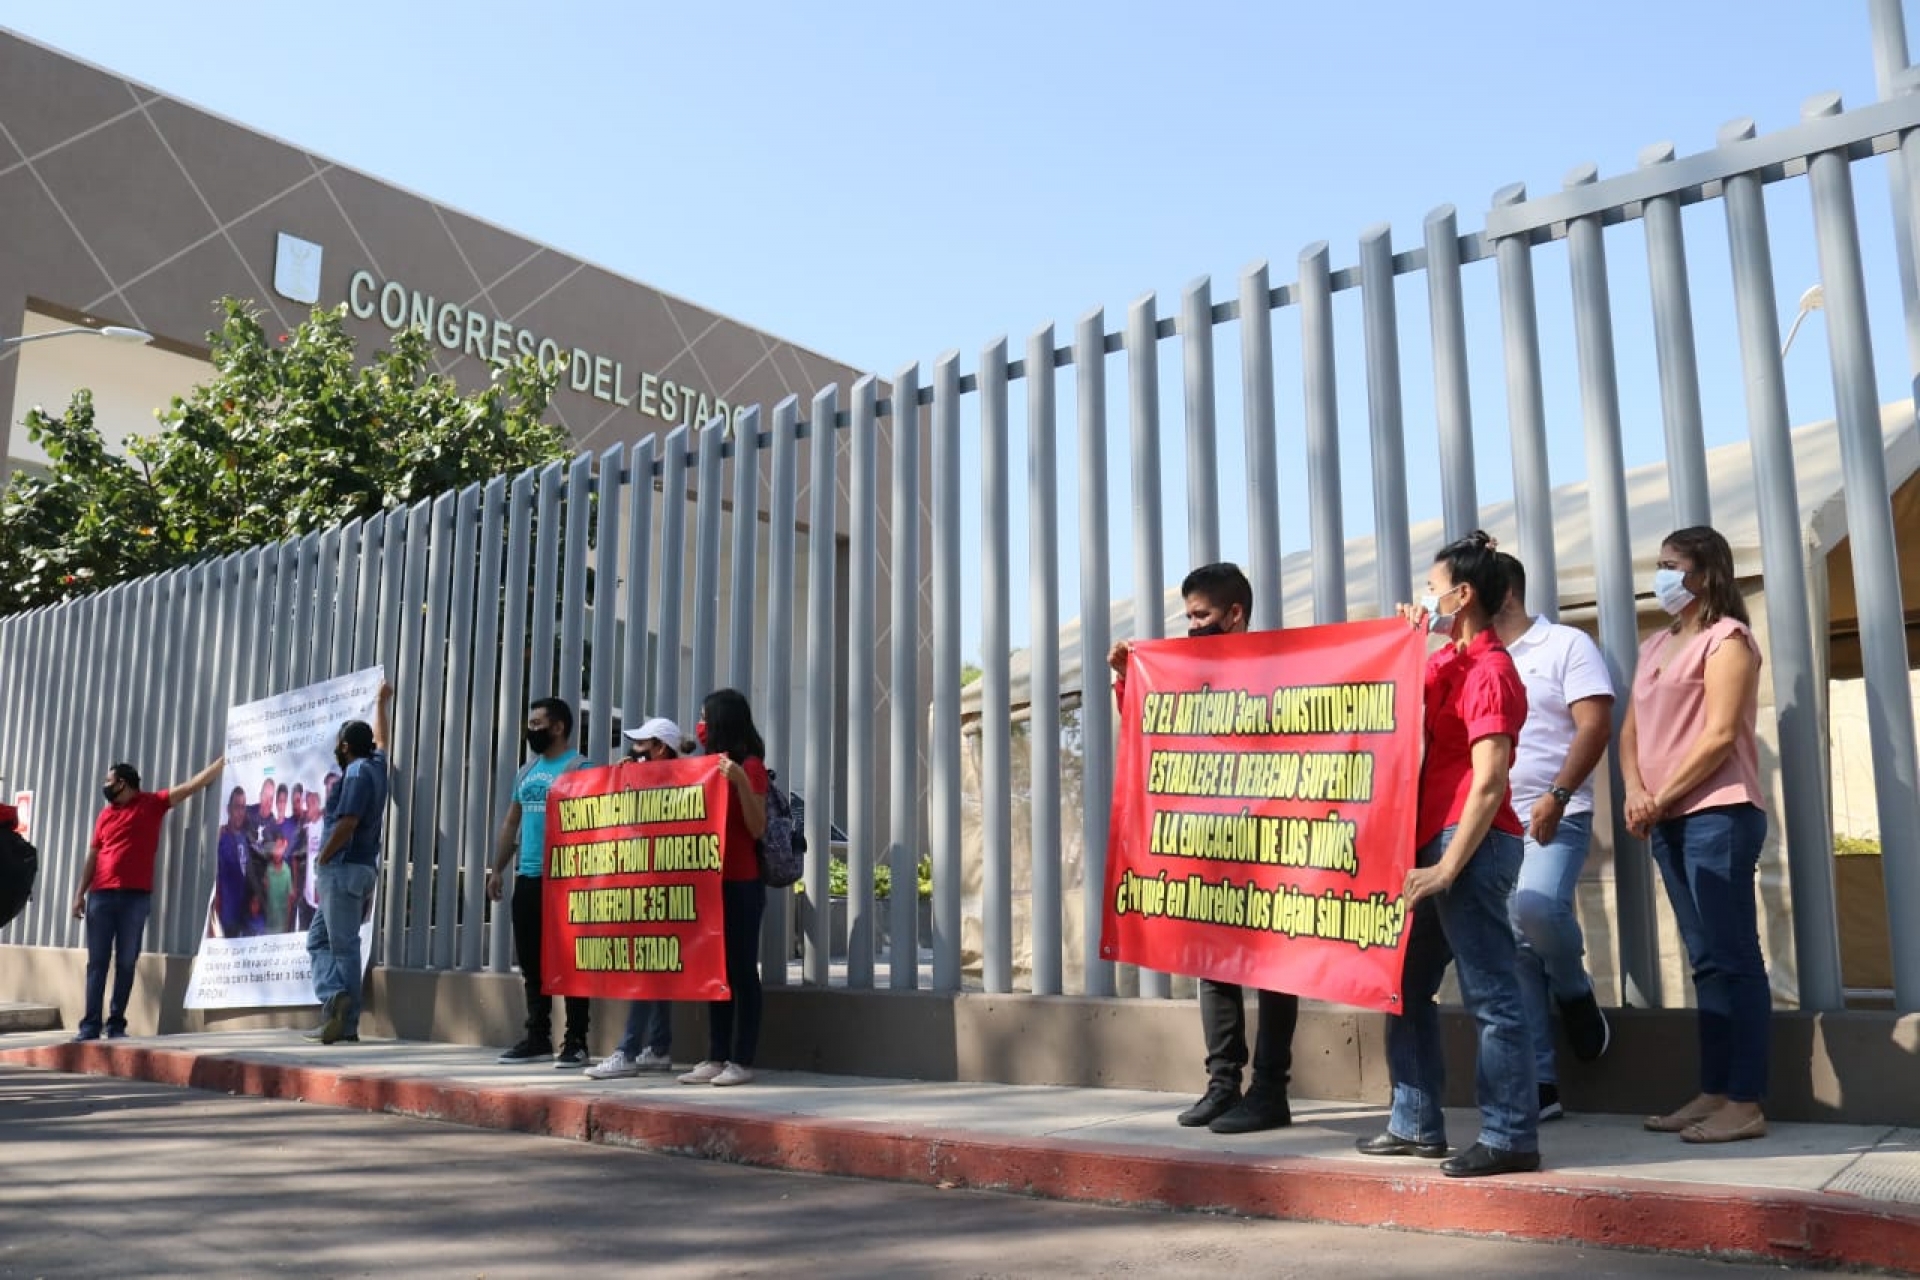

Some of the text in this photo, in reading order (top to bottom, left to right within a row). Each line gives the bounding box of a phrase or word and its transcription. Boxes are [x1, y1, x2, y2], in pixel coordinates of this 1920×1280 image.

[350, 270, 560, 380] CONGRESO
[571, 347, 630, 407] DEL
[1142, 683, 1395, 734] SI EL ARTÍCULO 3ero. CONSTITUCIONAL
[1148, 751, 1373, 801] ESTABLECE EL DERECHO SUPERIOR
[637, 784, 706, 823] INMEDIATA
[550, 846, 560, 878] A
[559, 845, 577, 878] LOS
[617, 837, 649, 874] PRONI
[653, 834, 722, 873] MORELOS,
[1151, 808, 1357, 876] A LA EDUCACIÓN DE LOS NIÑOS,
[633, 887, 648, 921] DE
[648, 886, 667, 921] 35
[668, 885, 697, 921] MIL
[1166, 881, 1186, 918] en
[1187, 875, 1245, 925] Morelos
[1246, 881, 1271, 929] los
[1272, 885, 1315, 938] dejan
[1316, 889, 1342, 938] sin
[1343, 892, 1405, 949] inglés?
[613, 936, 631, 971] DEL
[633, 935, 683, 972] ESTADO.
